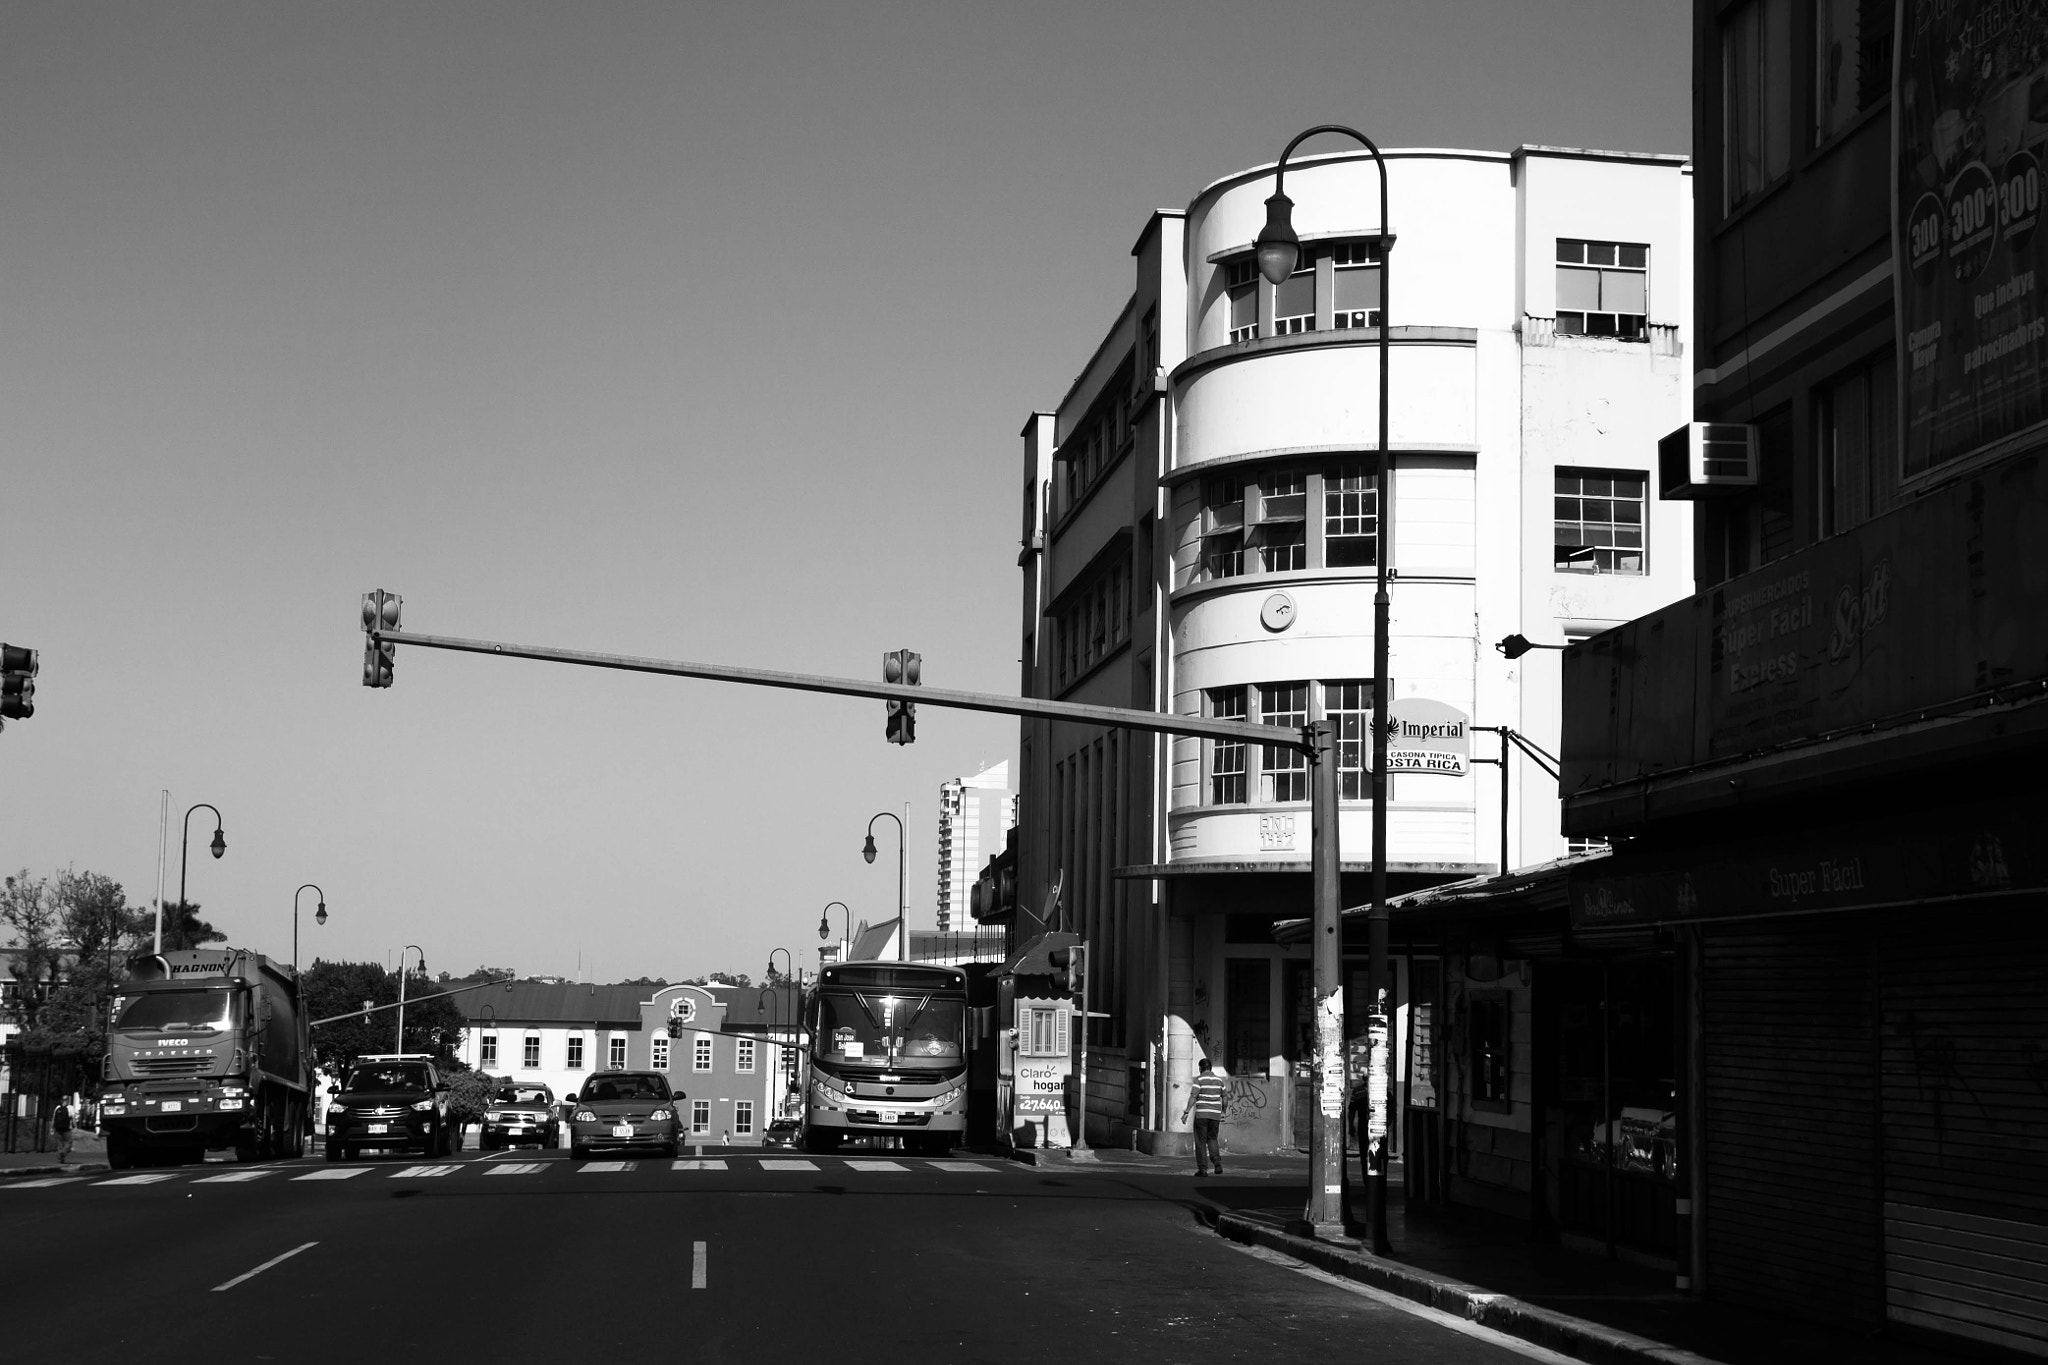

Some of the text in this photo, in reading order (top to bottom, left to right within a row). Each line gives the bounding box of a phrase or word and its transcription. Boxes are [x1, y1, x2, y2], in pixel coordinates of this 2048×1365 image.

[1912, 213, 1938, 257] 300
[2000, 167, 2039, 226] 300
[1974, 270, 2034, 319] Que incluya
[1768, 595, 1813, 640] Fácil
[1829, 559, 1891, 665] Scott
[1730, 652, 1797, 695] Express
[1402, 720, 1463, 740] Imperial
[1386, 758, 1462, 771] OSTA RICA
[1390, 751, 1457, 761] CASONA TIPICA
[1769, 856, 1865, 903] Super Fácil
[171, 963, 226, 974] HAGNON
[157, 1038, 189, 1047] IVECO
[1020, 1068, 1052, 1079] Claro
[1033, 1080, 1066, 1092] hogar
